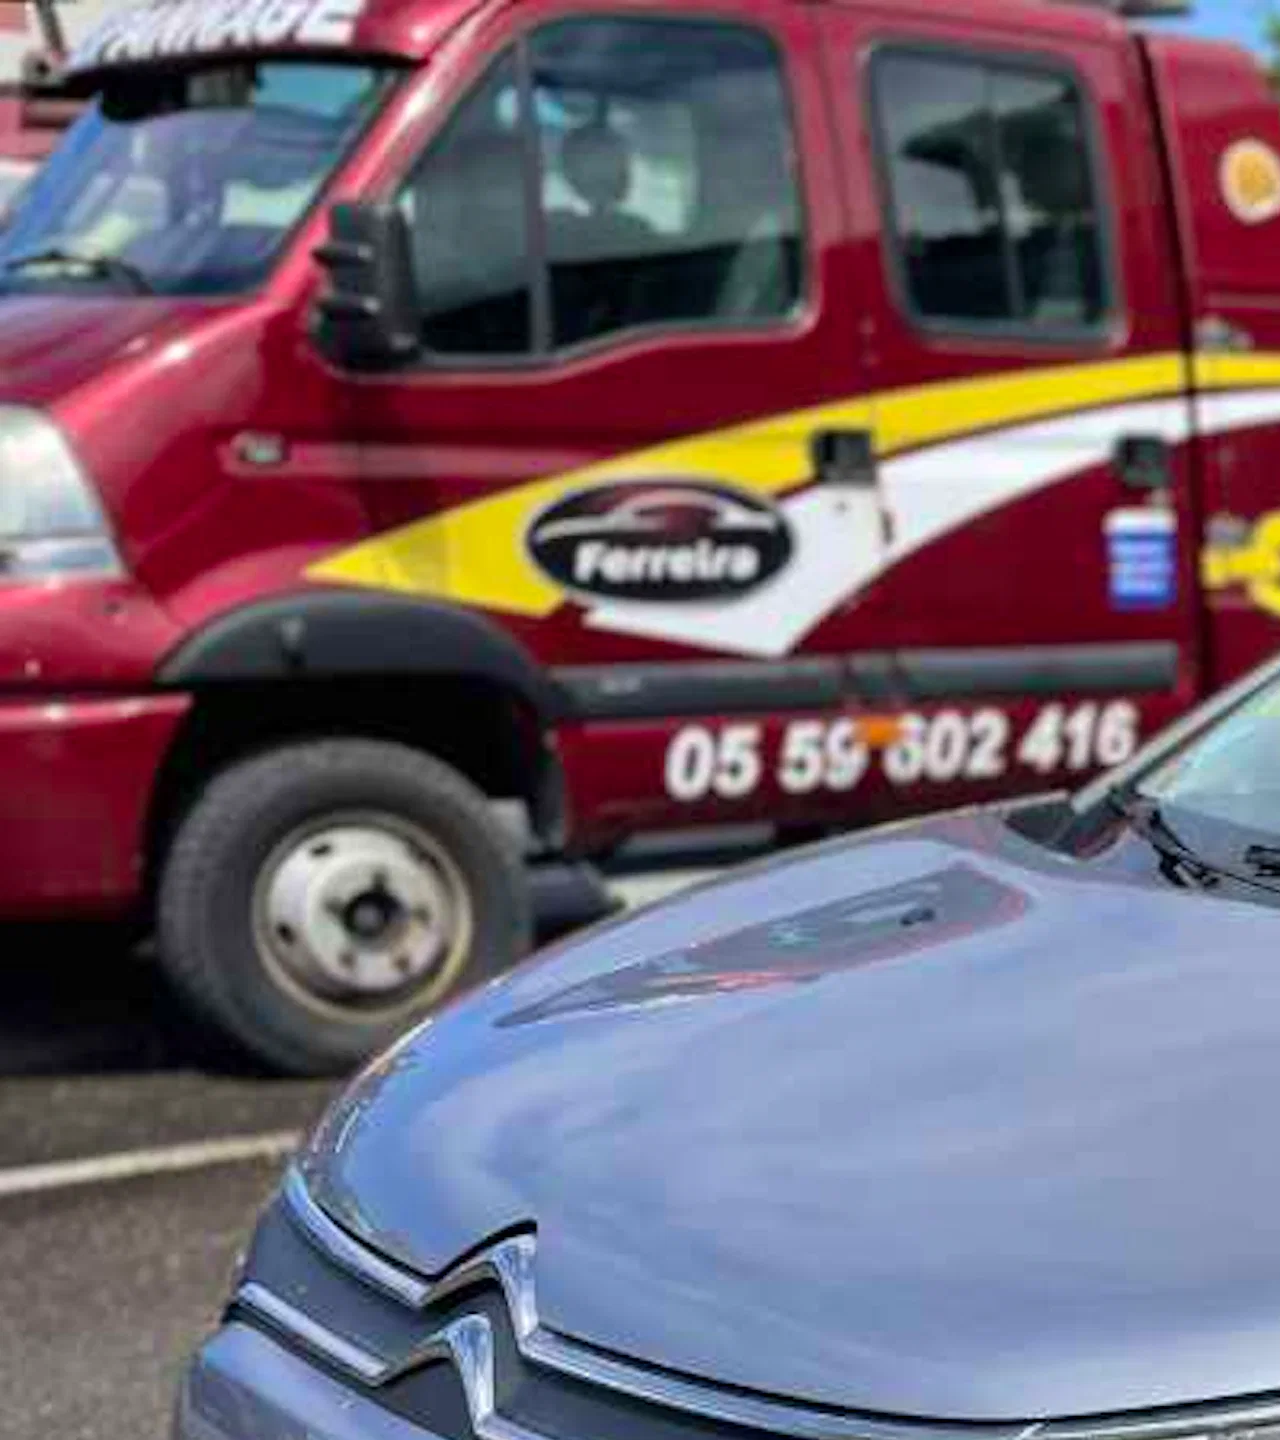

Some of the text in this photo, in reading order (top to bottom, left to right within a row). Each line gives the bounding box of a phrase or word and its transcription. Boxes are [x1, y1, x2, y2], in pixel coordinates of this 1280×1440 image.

[666, 697, 1139, 802] 05 59 602 416
